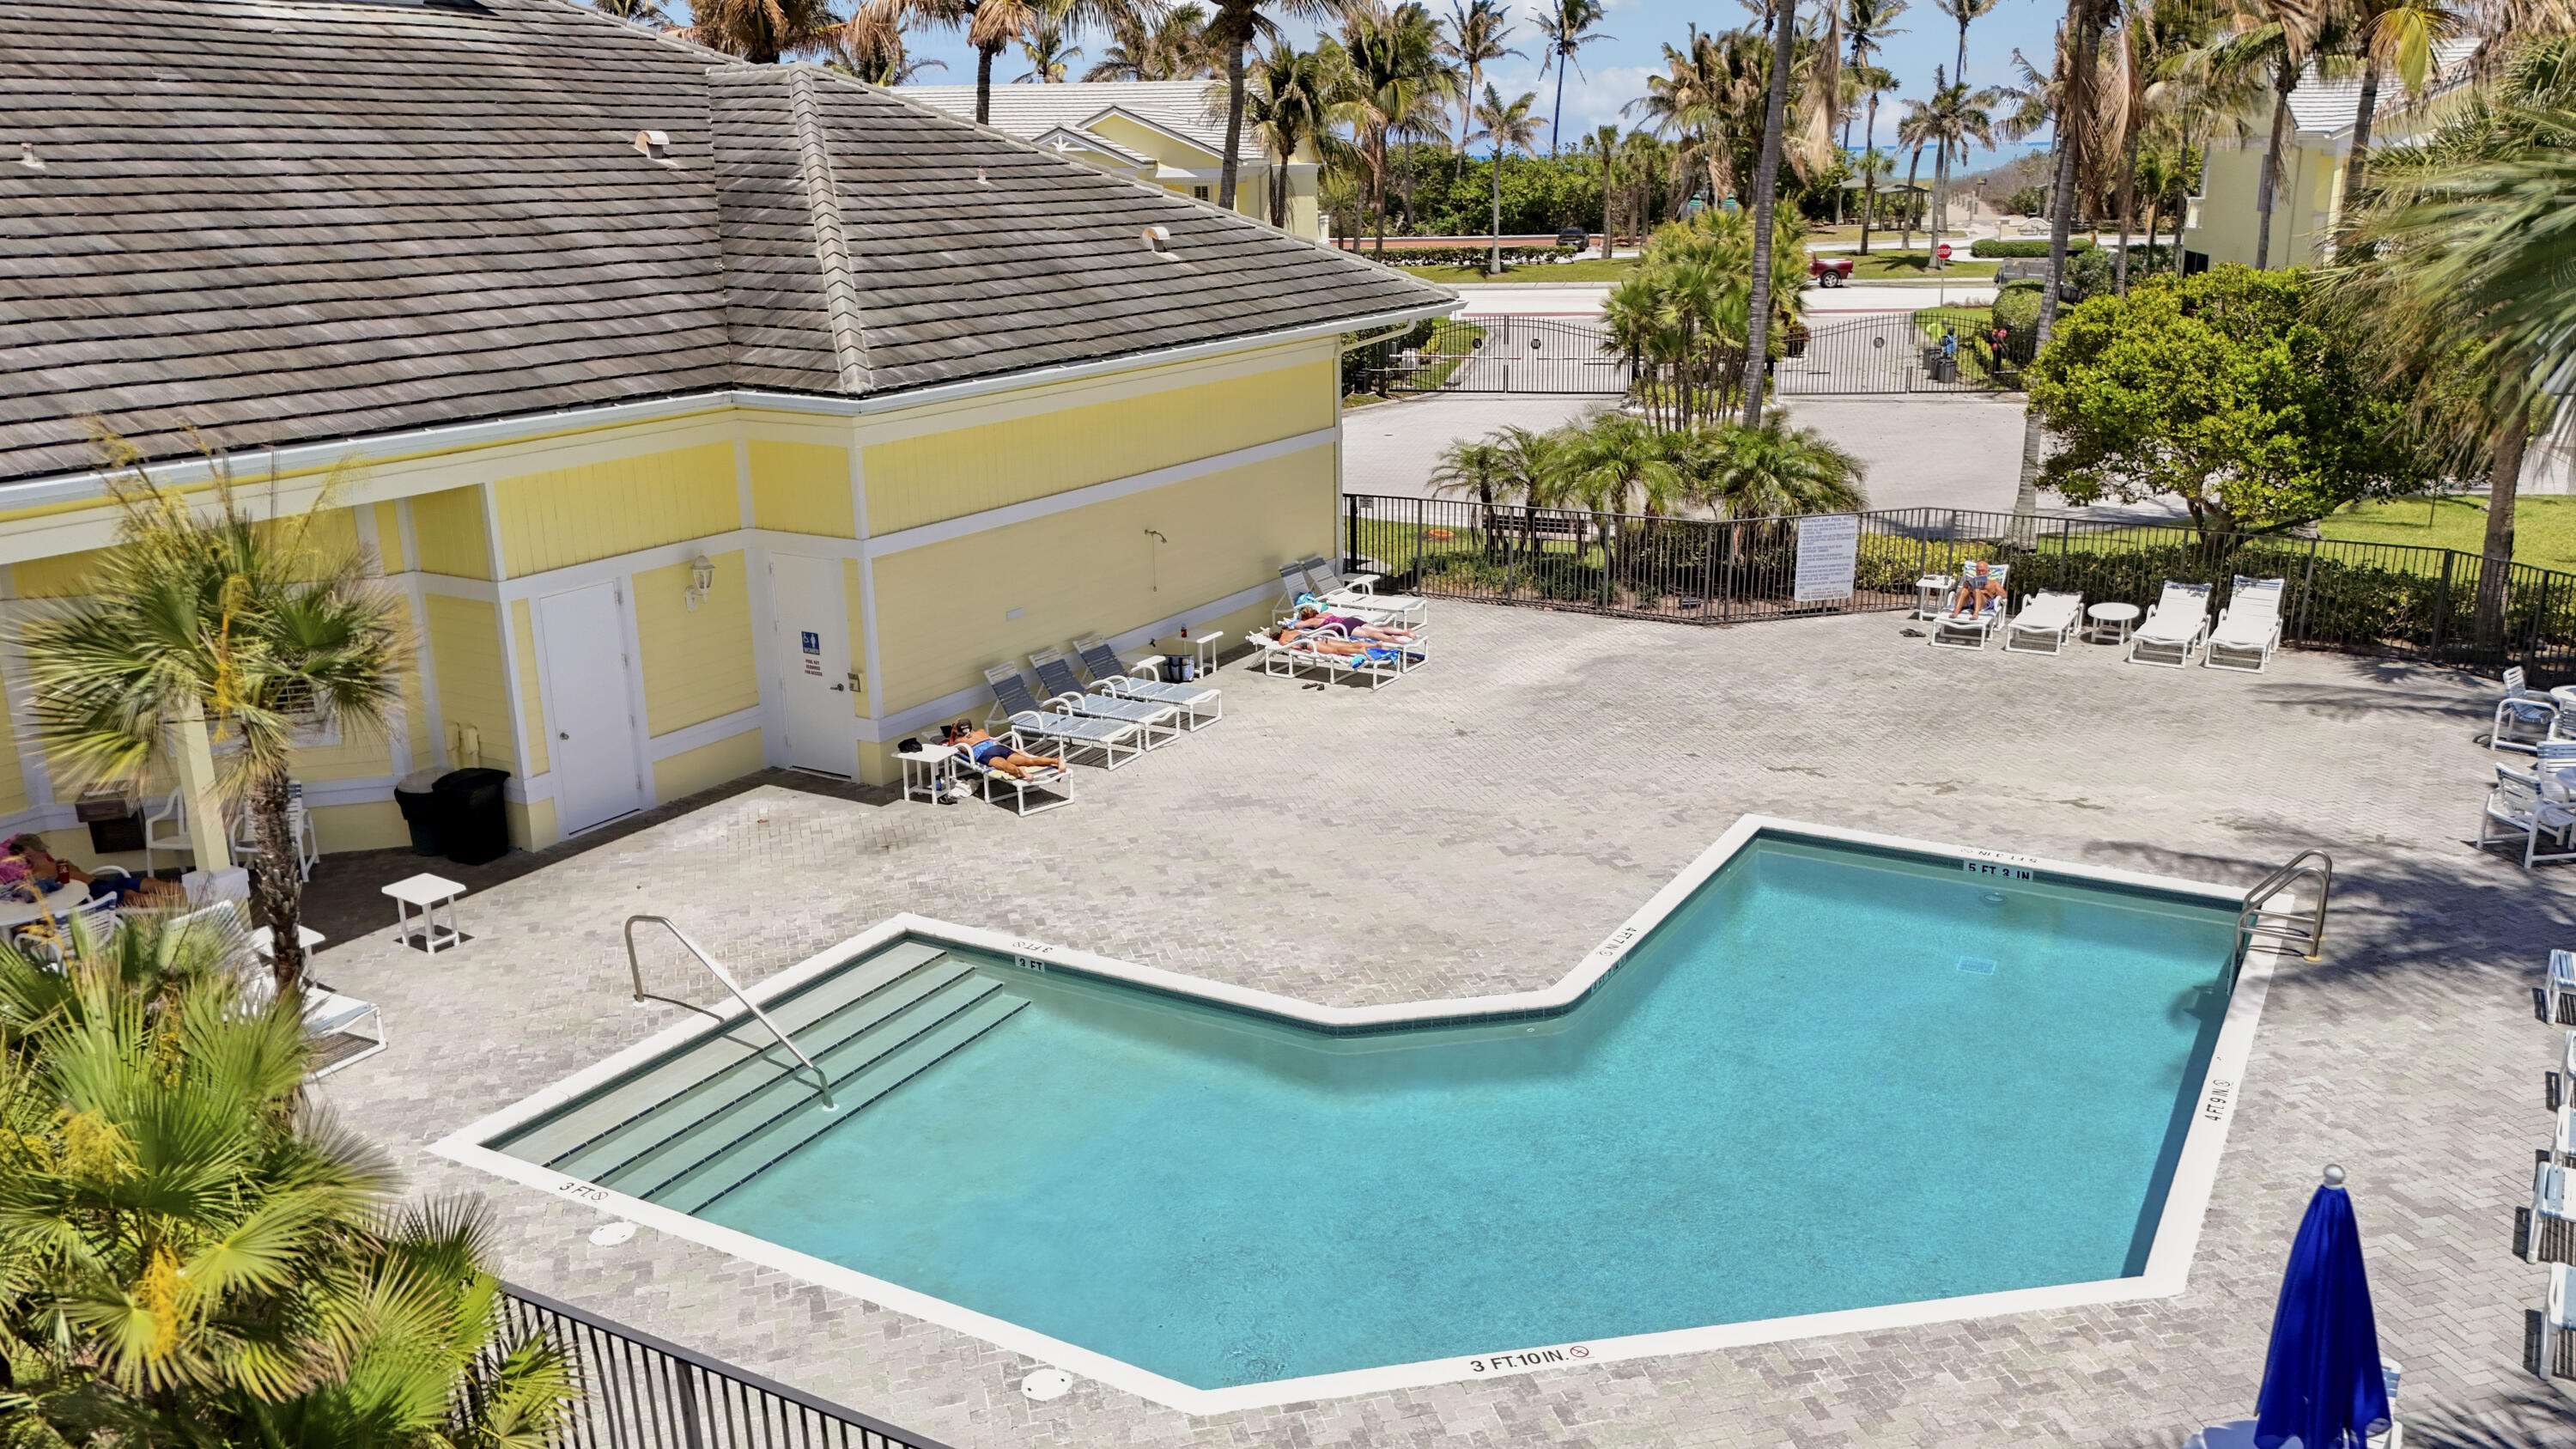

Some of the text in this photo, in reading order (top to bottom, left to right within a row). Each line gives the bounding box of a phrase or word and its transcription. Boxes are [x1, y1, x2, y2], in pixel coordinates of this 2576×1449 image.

[1968, 863, 2030, 880] 5 FT 3 IN
[1019, 958, 1042, 971] 3 FT
[559, 1182, 574, 1191] 3
[1470, 1360, 1485, 1373] 3
